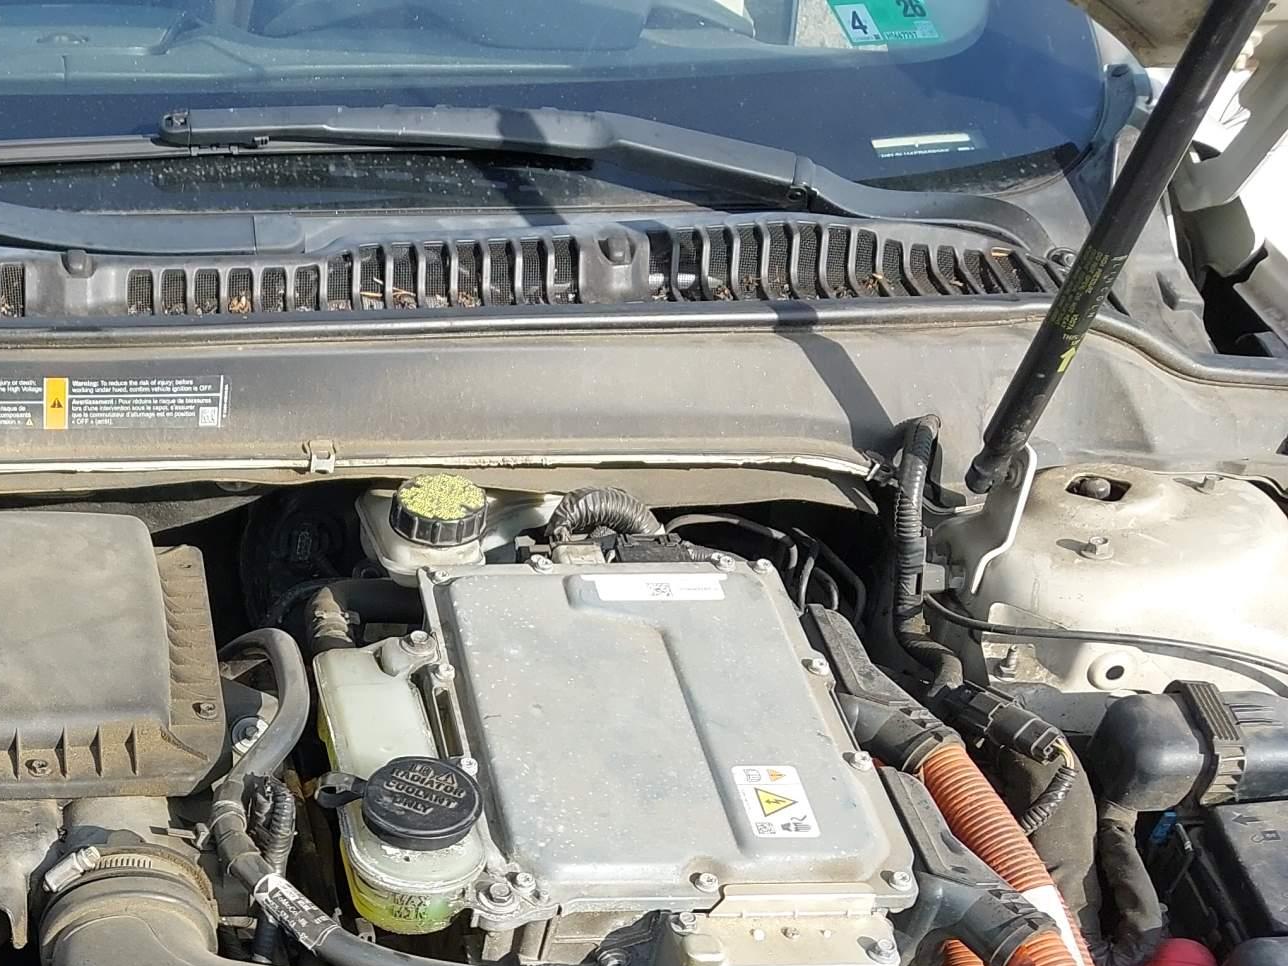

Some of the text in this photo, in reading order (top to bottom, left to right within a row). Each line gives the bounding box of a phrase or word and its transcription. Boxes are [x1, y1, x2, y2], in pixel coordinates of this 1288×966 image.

[852, 10, 868, 35] 4
[11, 378, 18, 386] or
[108, 379, 128, 387] reduce
[128, 379, 138, 387] the
[392, 768, 466, 798] RADIATOR
[384, 781, 458, 809] COOLANT
[392, 795, 433, 815] ONLY
